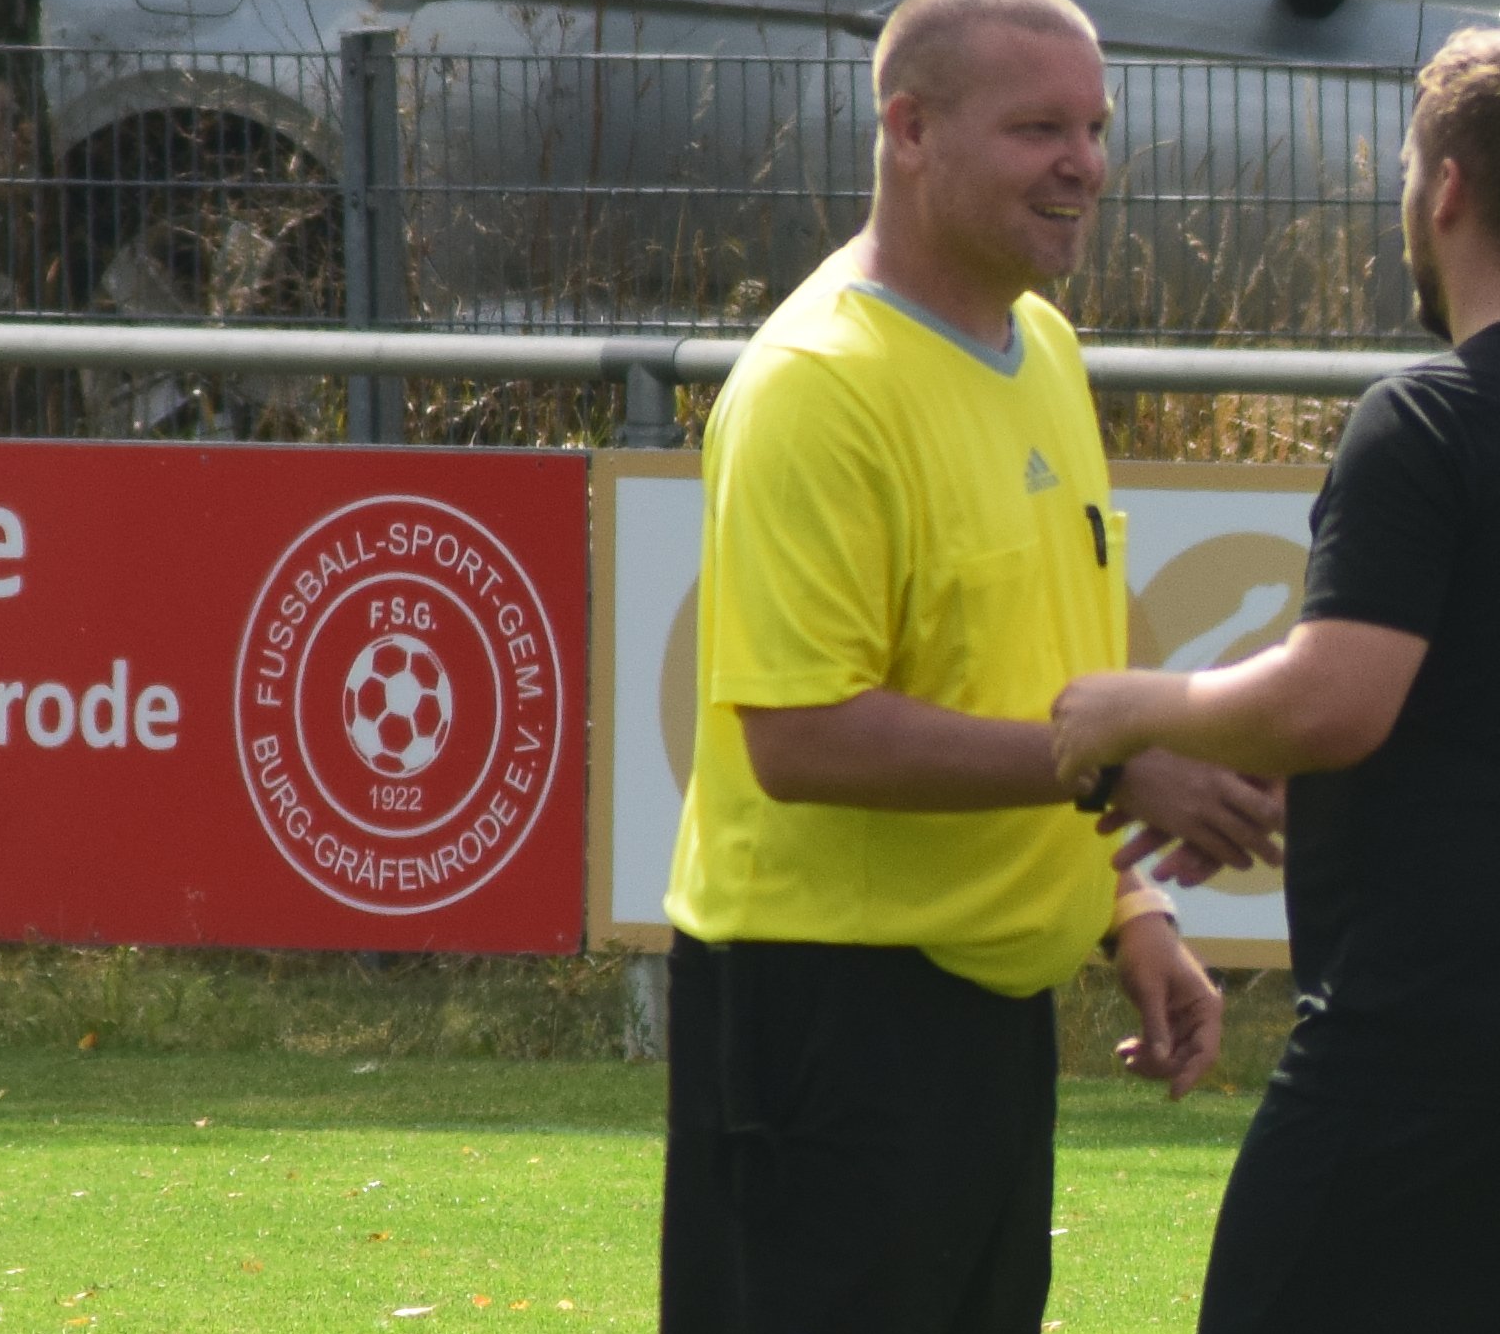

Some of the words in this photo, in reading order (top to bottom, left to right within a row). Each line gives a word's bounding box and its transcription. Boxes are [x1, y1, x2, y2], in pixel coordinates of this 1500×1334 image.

[257, 522, 543, 712] FUSSBALL-SPORT-GEM.
[369, 596, 438, 631] F.S.G.
[504, 722, 544, 794] E.V.
[252, 733, 518, 892] BURG-GRÄFENRODE
[369, 785, 423, 811] 1922
